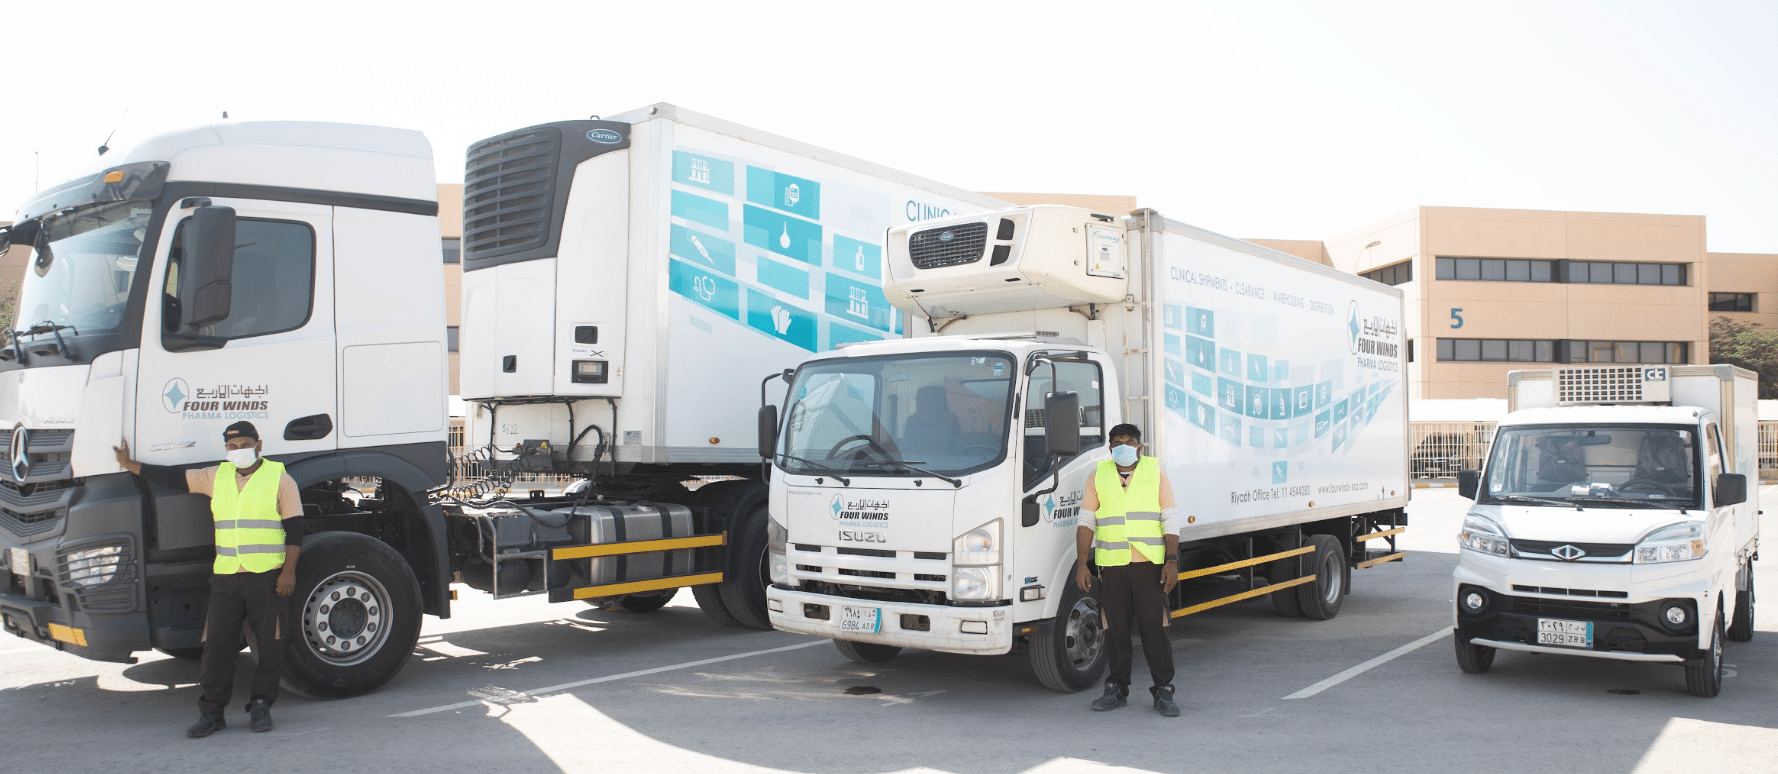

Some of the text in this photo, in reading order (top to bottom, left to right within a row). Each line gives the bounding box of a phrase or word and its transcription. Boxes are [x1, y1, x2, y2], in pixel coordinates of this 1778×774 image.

[591, 131, 618, 140] Carrier
[1170, 266, 1198, 285] CLINICAL
[1198, 273, 1228, 291] SHIPMENTS
[1235, 282, 1265, 300] CLEARANCE
[1451, 308, 1464, 329] 5
[1358, 337, 1398, 358] FOUR WINDS
[1357, 357, 1376, 370] PHARMA
[183, 400, 269, 412] FOUR WINDS
[182, 411, 269, 420] PHARMA LOGISTICS
[1230, 490, 1251, 506] Riyadh
[1252, 488, 1270, 502] Office
[1281, 487, 1288, 499] 11
[1289, 484, 1310, 498] 4544080
[840, 511, 889, 521] FOUR WINDS
[1053, 507, 1072, 519] FOUR
[838, 529, 887, 543] ISUZU
[842, 619, 860, 630] 6984
[1540, 632, 1565, 644] 3029
